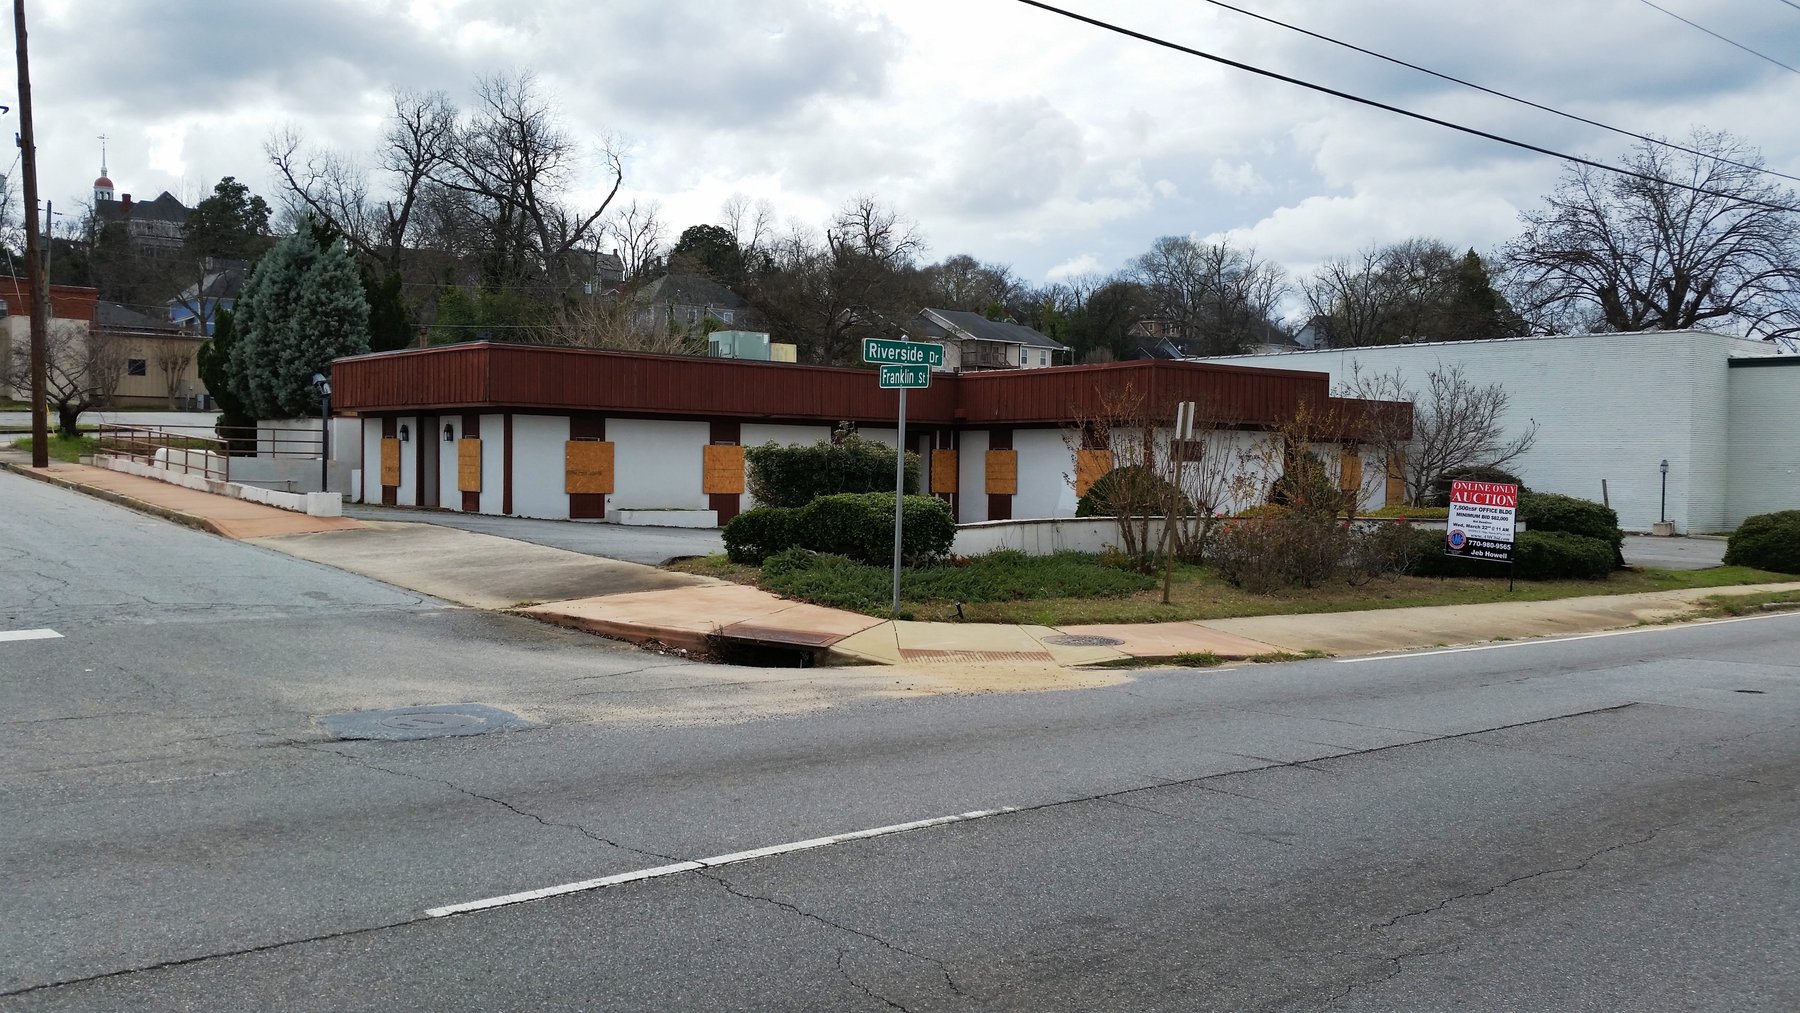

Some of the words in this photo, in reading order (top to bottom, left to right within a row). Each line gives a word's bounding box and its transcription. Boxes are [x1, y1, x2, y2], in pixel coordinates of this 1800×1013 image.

[869, 343, 923, 362] Riverside
[929, 352, 939, 363] Dr
[882, 369, 914, 384] Franklin
[918, 372, 926, 383] St
[1453, 482, 1490, 492] ONLINE
[1493, 485, 1516, 494] ONLY
[1452, 492, 1514, 506] AUCTION
[1468, 540, 1511, 550] 770-980-9565
